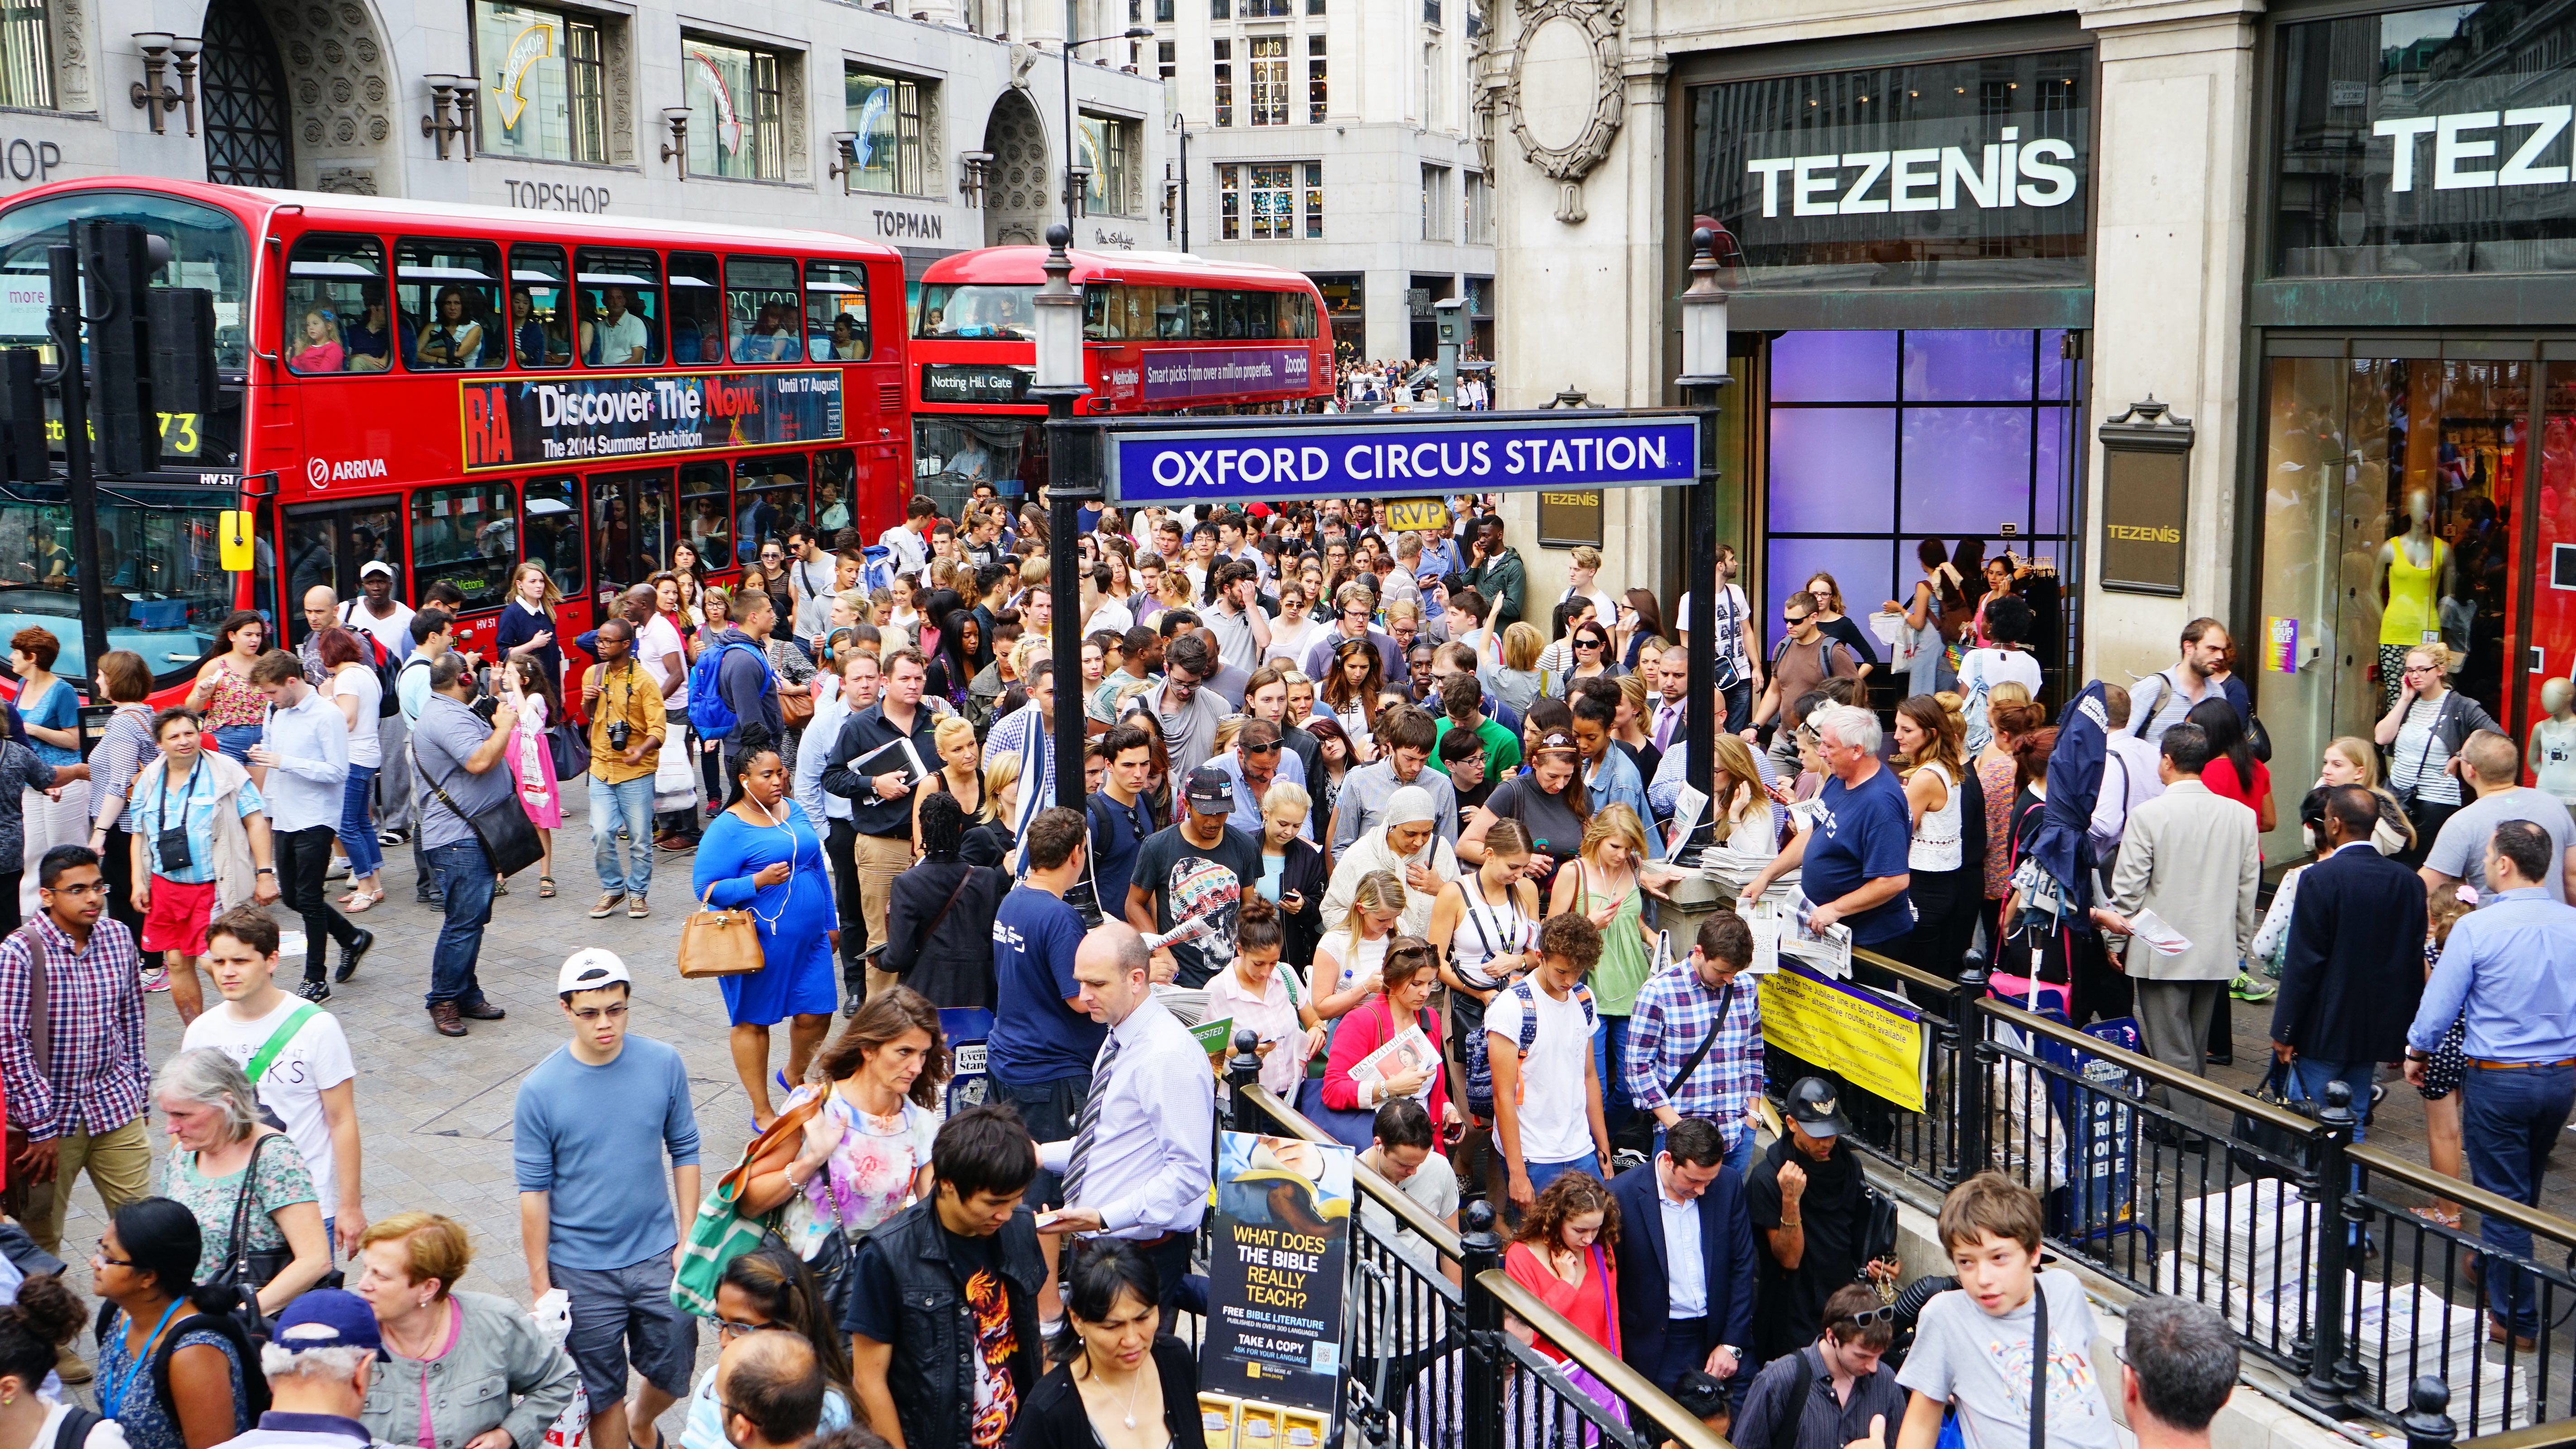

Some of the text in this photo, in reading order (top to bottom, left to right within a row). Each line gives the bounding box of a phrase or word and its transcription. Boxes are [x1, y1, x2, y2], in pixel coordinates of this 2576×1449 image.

[2374, 105, 2576, 192] TEZ
[505, 179, 610, 214] TOPSHOP
[873, 210, 942, 239] TOPMAN
[10, 291, 45, 303] more
[1147, 361, 1273, 385] Smart picks from over a million properties.
[1284, 354, 1307, 376] Zoopla
[778, 377, 839, 395] Until 17 August
[932, 375, 1012, 391] Notting Hill Gate
[1112, 369, 1139, 385] Metroline
[539, 379, 759, 427] Discover The Now.
[464, 386, 513, 465] RA
[542, 429, 702, 458] The 2014 Summer Exhibition
[332, 459, 387, 480] ARRIVA
[1152, 435, 1666, 486] OXFORD CIRCUS STATION
[201, 474, 234, 485] HV 51
[1391, 503, 1440, 525] RVP
[476, 617, 496, 630] HV 51
[2271, 627, 2294, 636] YOUR
[1762, 978, 1774, 992] early
[1776, 983, 1806, 1000] December
[1811, 997, 1843, 1017] alternative
[1845, 1011, 1866, 1026] routes
[1867, 1021, 1876, 1030] are
[1878, 1026, 1906, 1043] available
[1791, 978, 1801, 987] for
[1802, 981, 1812, 992] the
[1814, 985, 1835, 1001] Jubilee
[1837, 994, 1849, 1006] line
[1858, 1004, 1874, 1018] Bond
[1876, 1013, 1897, 1027] Street
[1898, 1021, 1913, 1034] until
[1194, 1026, 1224, 1040] RESTED
[1351, 1061, 1368, 1078] PM'S
[1368, 1049, 1386, 1064] GAZA
[1384, 1029, 1414, 1053] FAILURE
[1233, 1225, 1325, 1254] WHAT DOES
[1237, 1245, 1319, 1272] THE BIBLE
[1248, 1266, 1305, 1289] REALLY
[1246, 1285, 1307, 1309] TEACH?
[1223, 1305, 1324, 1330] FREE BIBLE LITERATURE
[1227, 1317, 1255, 1328] PUBLISHED
[1288, 1327, 1319, 1338] LANGUAGES
[1233, 1345, 1307, 1364] ASK FOR YOUR LANGUAGE
[1238, 1333, 1304, 1354] TAKE A COPY
